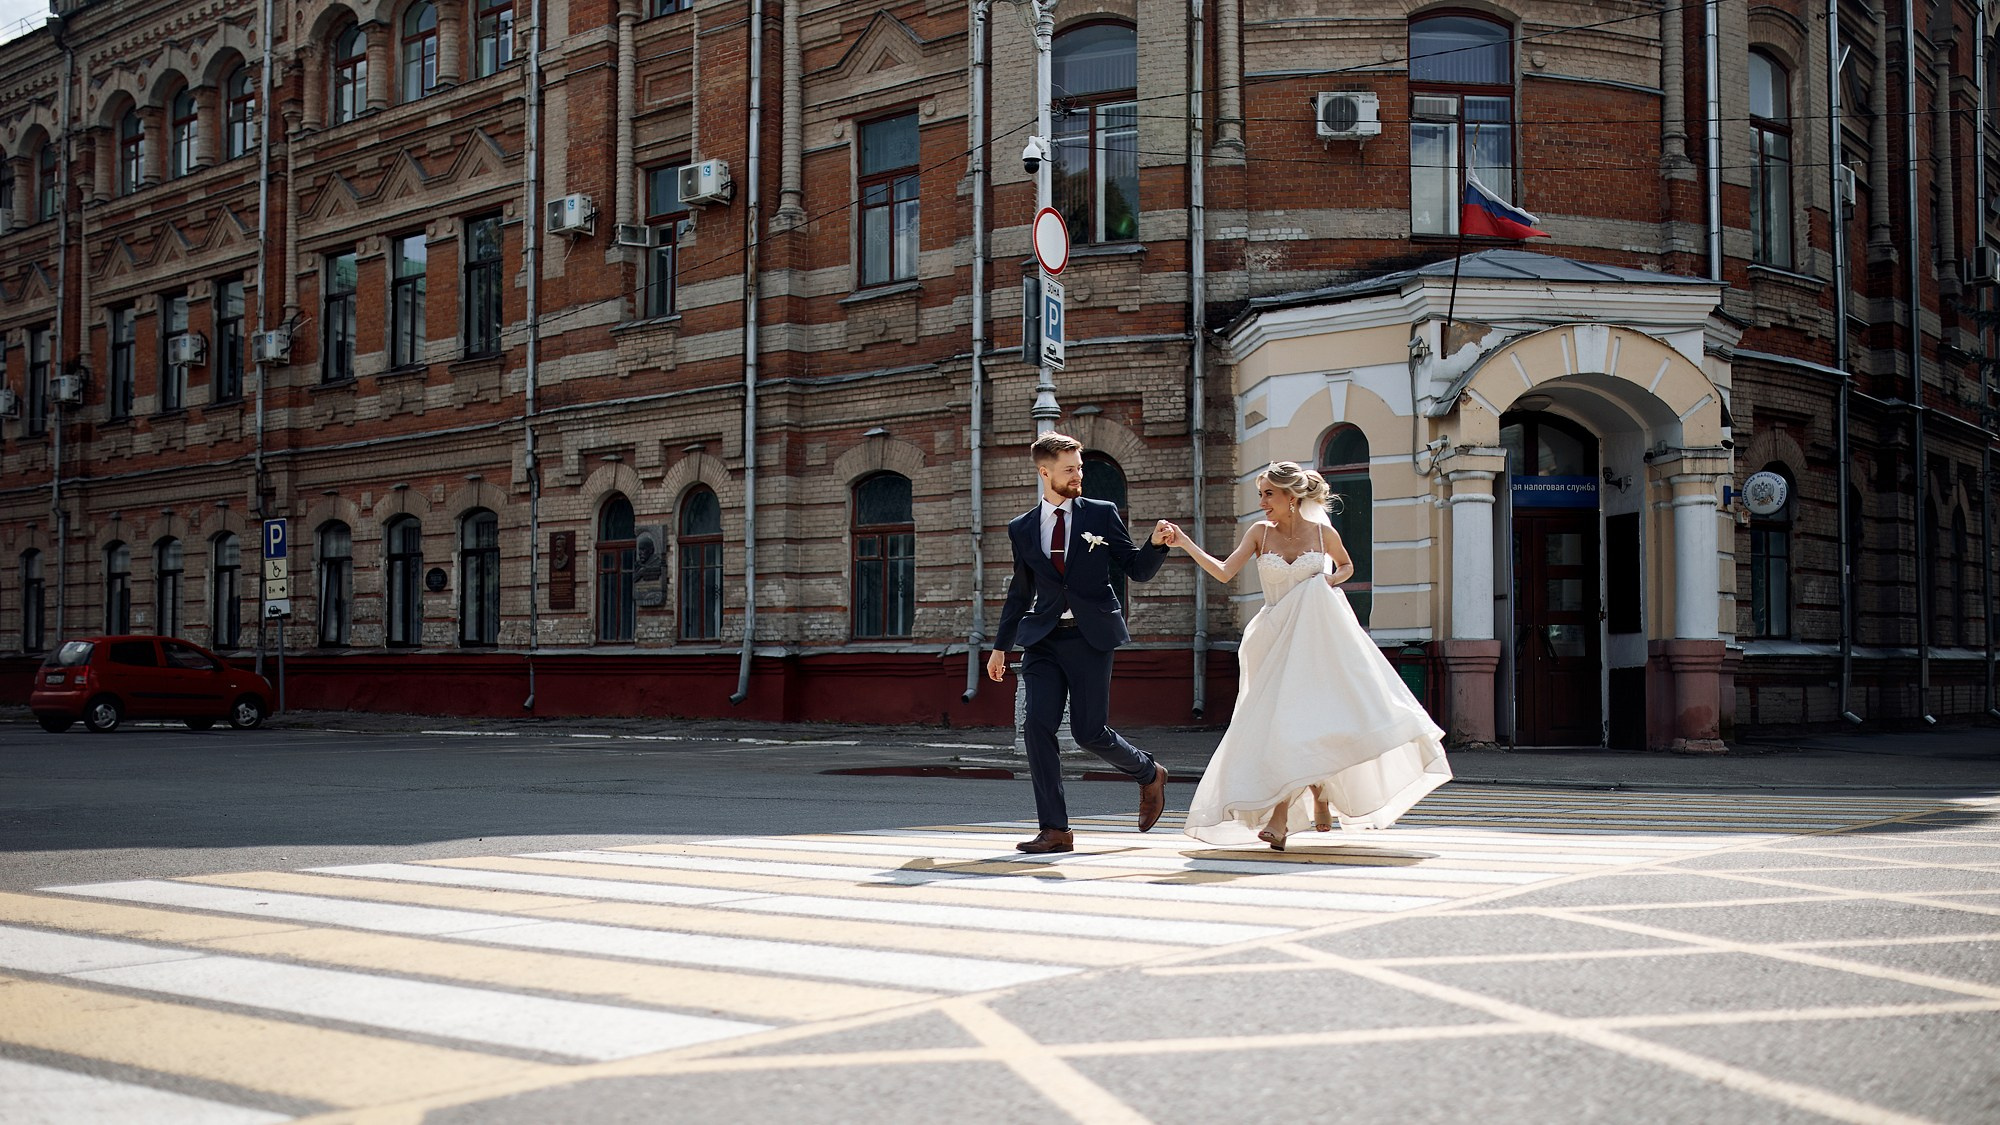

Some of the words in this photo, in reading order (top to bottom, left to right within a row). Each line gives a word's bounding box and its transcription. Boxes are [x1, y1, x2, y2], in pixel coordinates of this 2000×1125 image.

[1049, 301, 1059, 336] P
[1566, 483, 1596, 493] служба
[270, 524, 283, 555] P
